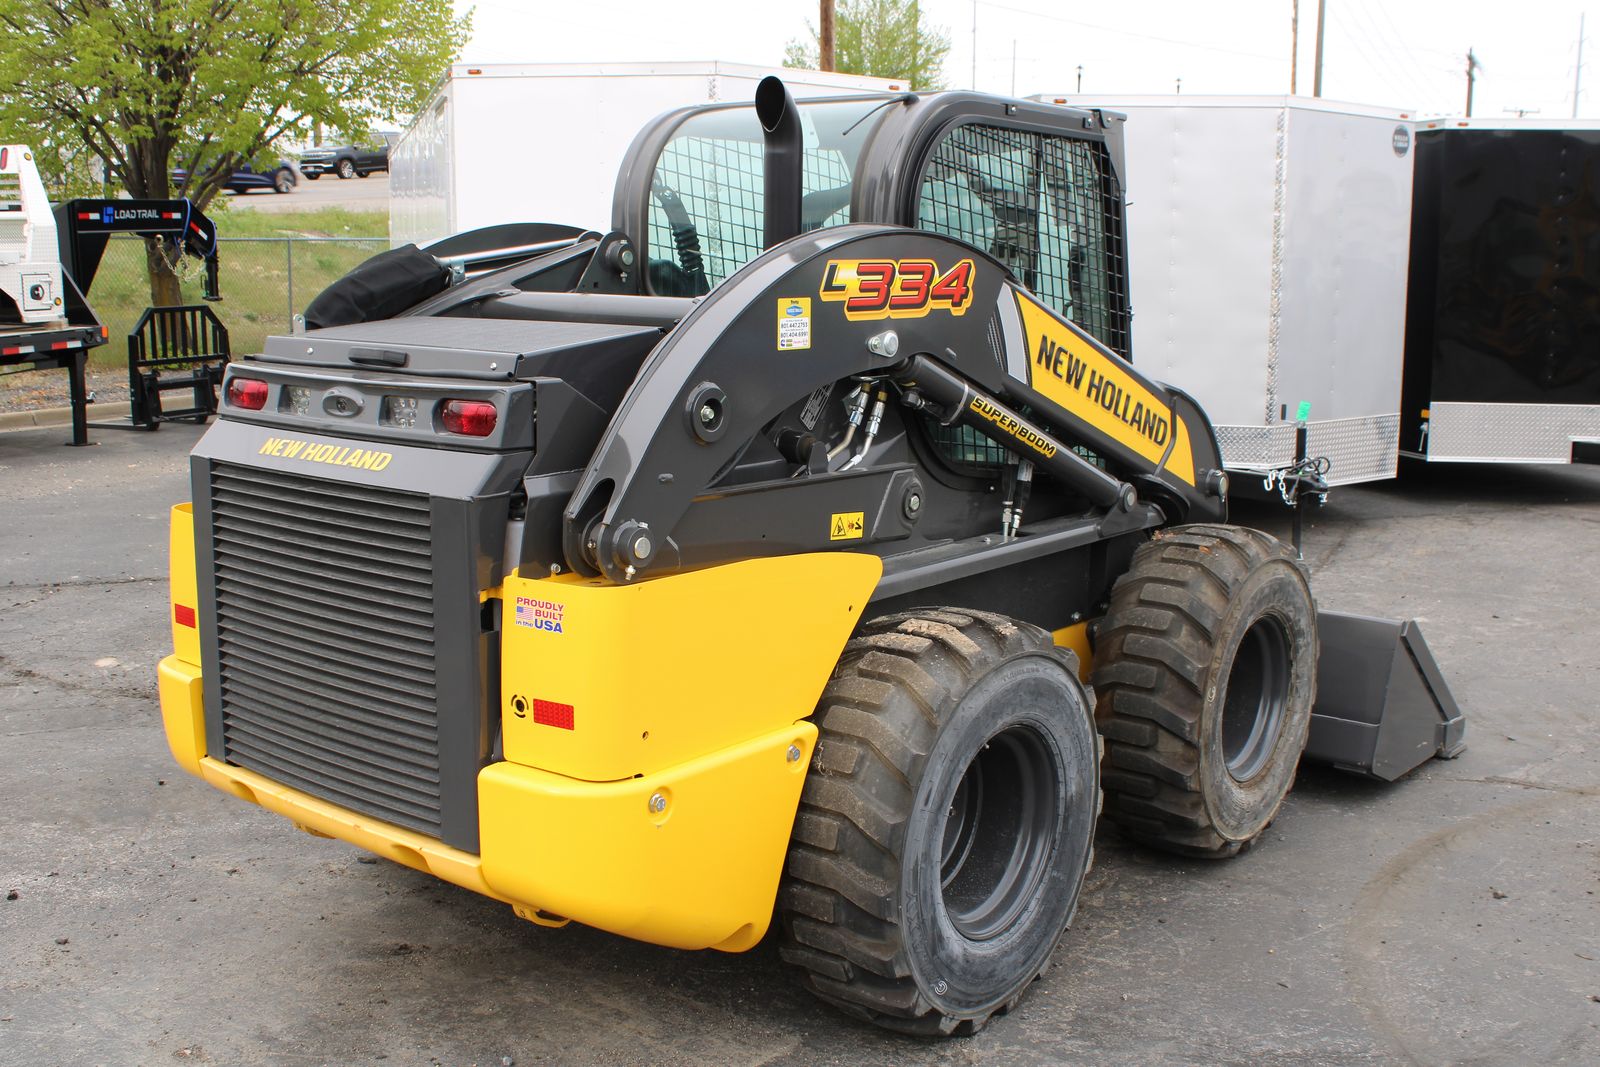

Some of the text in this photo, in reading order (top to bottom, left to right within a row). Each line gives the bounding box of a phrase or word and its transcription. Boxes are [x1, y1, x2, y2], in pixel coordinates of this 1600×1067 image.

[114, 209, 159, 219] LOAD TRAIL
[821, 260, 975, 317] L334
[1036, 334, 1168, 446] NEW HOLLAND
[971, 397, 1056, 456] SUPER BOOM
[258, 438, 393, 472] NEW HOLLAND
[516, 596, 564, 612] PROUDLY
[535, 609, 563, 621] BUILT
[534, 618, 563, 633] USA
